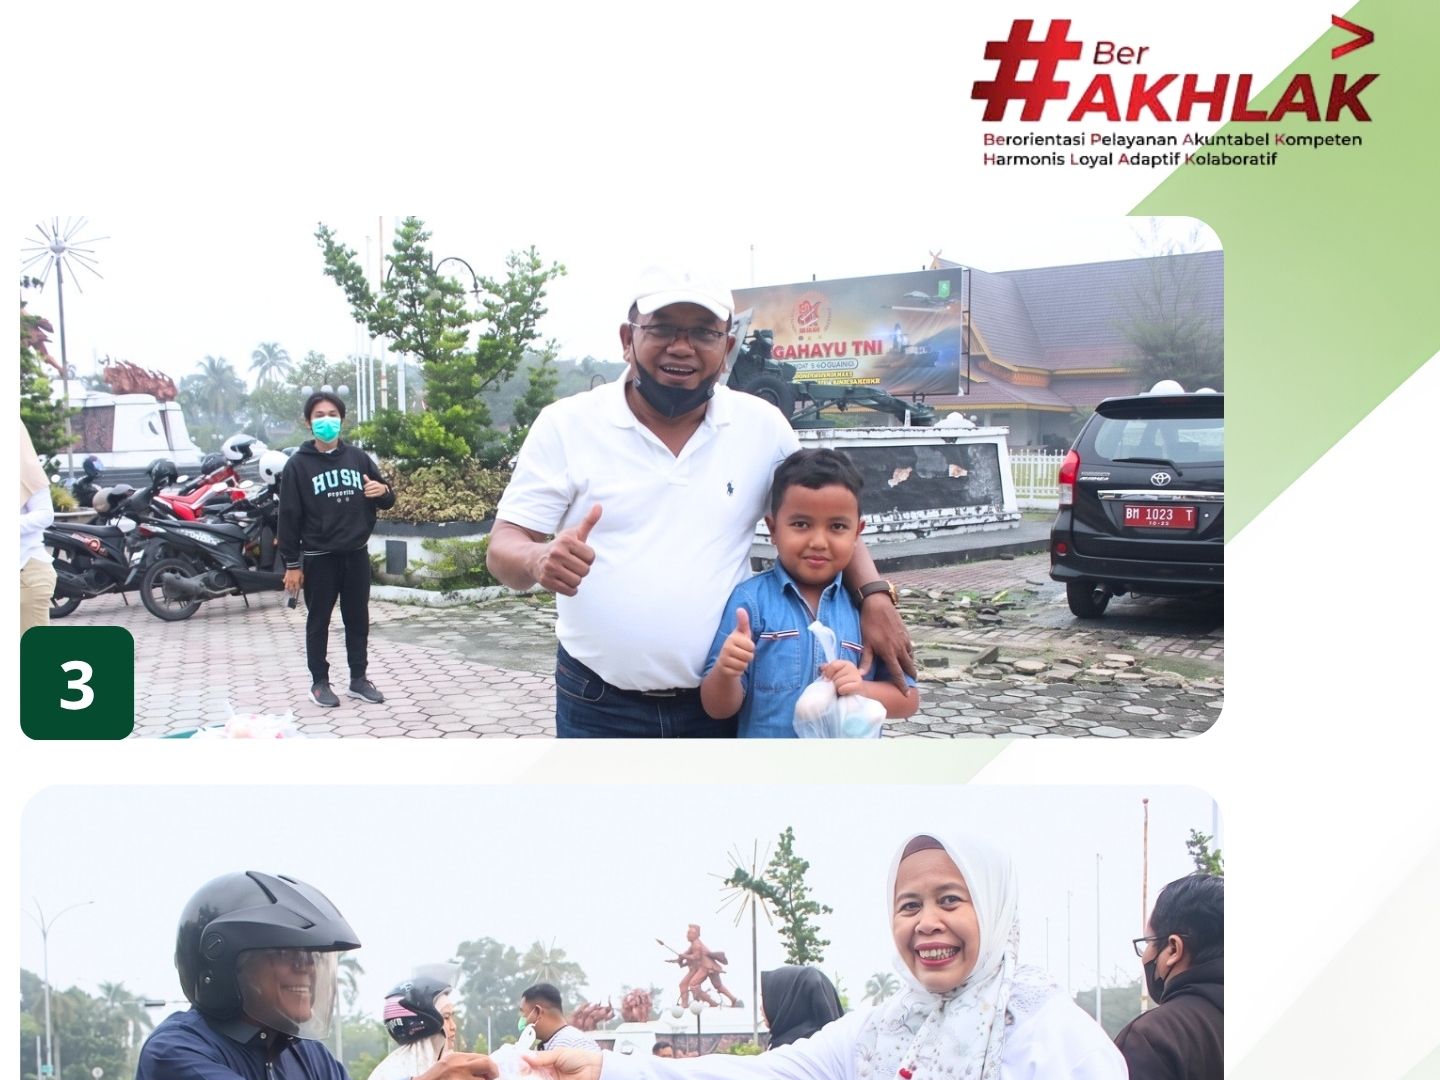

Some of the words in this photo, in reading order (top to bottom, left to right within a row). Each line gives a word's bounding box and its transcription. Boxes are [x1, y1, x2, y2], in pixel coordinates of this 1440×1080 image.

[852, 340, 883, 356] TNI
[312, 469, 363, 495] HUSH
[1126, 508, 1140, 519] BM
[1146, 509, 1173, 520] 1023
[1186, 510, 1193, 521] T
